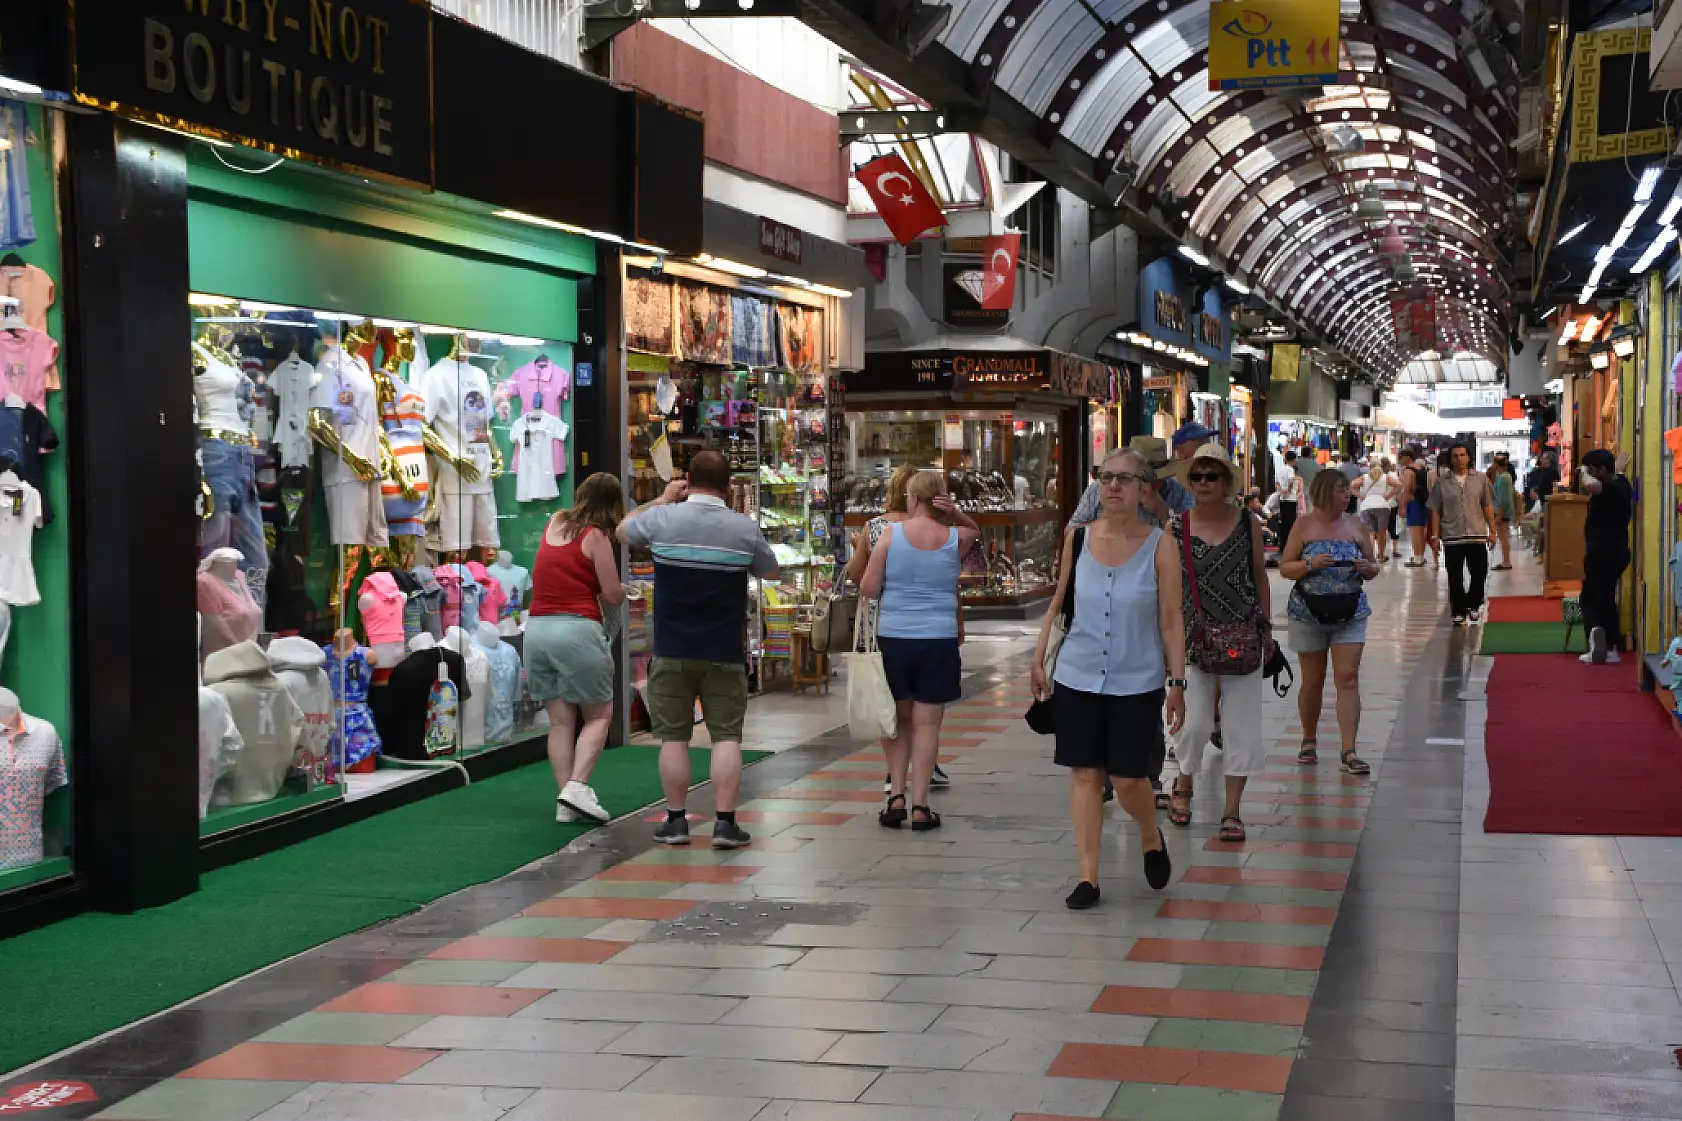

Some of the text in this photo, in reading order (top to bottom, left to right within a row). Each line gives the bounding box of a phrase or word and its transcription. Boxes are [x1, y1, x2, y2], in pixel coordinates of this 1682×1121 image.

[184, 0, 389, 74] HY-NOT
[1248, 38, 1291, 68] Ptt
[144, 17, 393, 156] BOUTIQUE
[911, 357, 940, 370] SINCE
